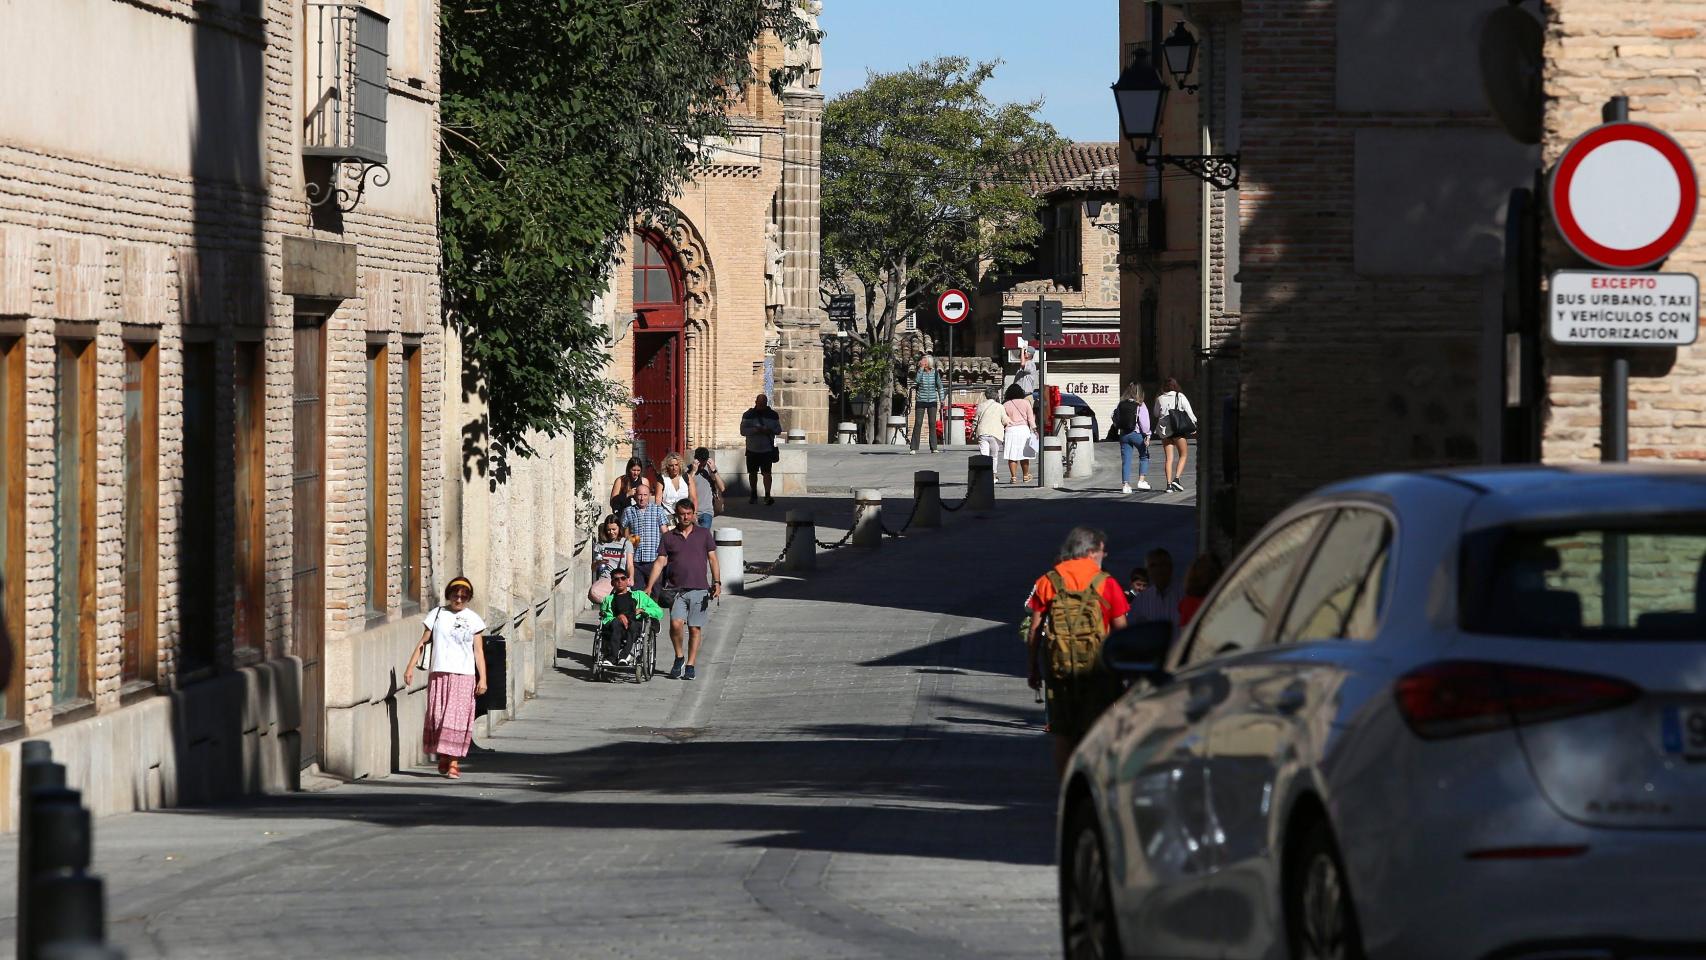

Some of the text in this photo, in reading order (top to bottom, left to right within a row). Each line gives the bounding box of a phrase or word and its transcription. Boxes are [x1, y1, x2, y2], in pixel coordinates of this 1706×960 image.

[1591, 278, 1657, 289] EXCEPTO
[1556, 294, 1586, 305] BUS
[1660, 295, 1691, 306] TAXI
[1557, 310, 1690, 323] Y VEHÍCULOS CON
[1569, 326, 1678, 339] AUTORIZACIÓN
[1037, 334, 1120, 346] STAURA
[1066, 383, 1109, 394] Cafe Bar
